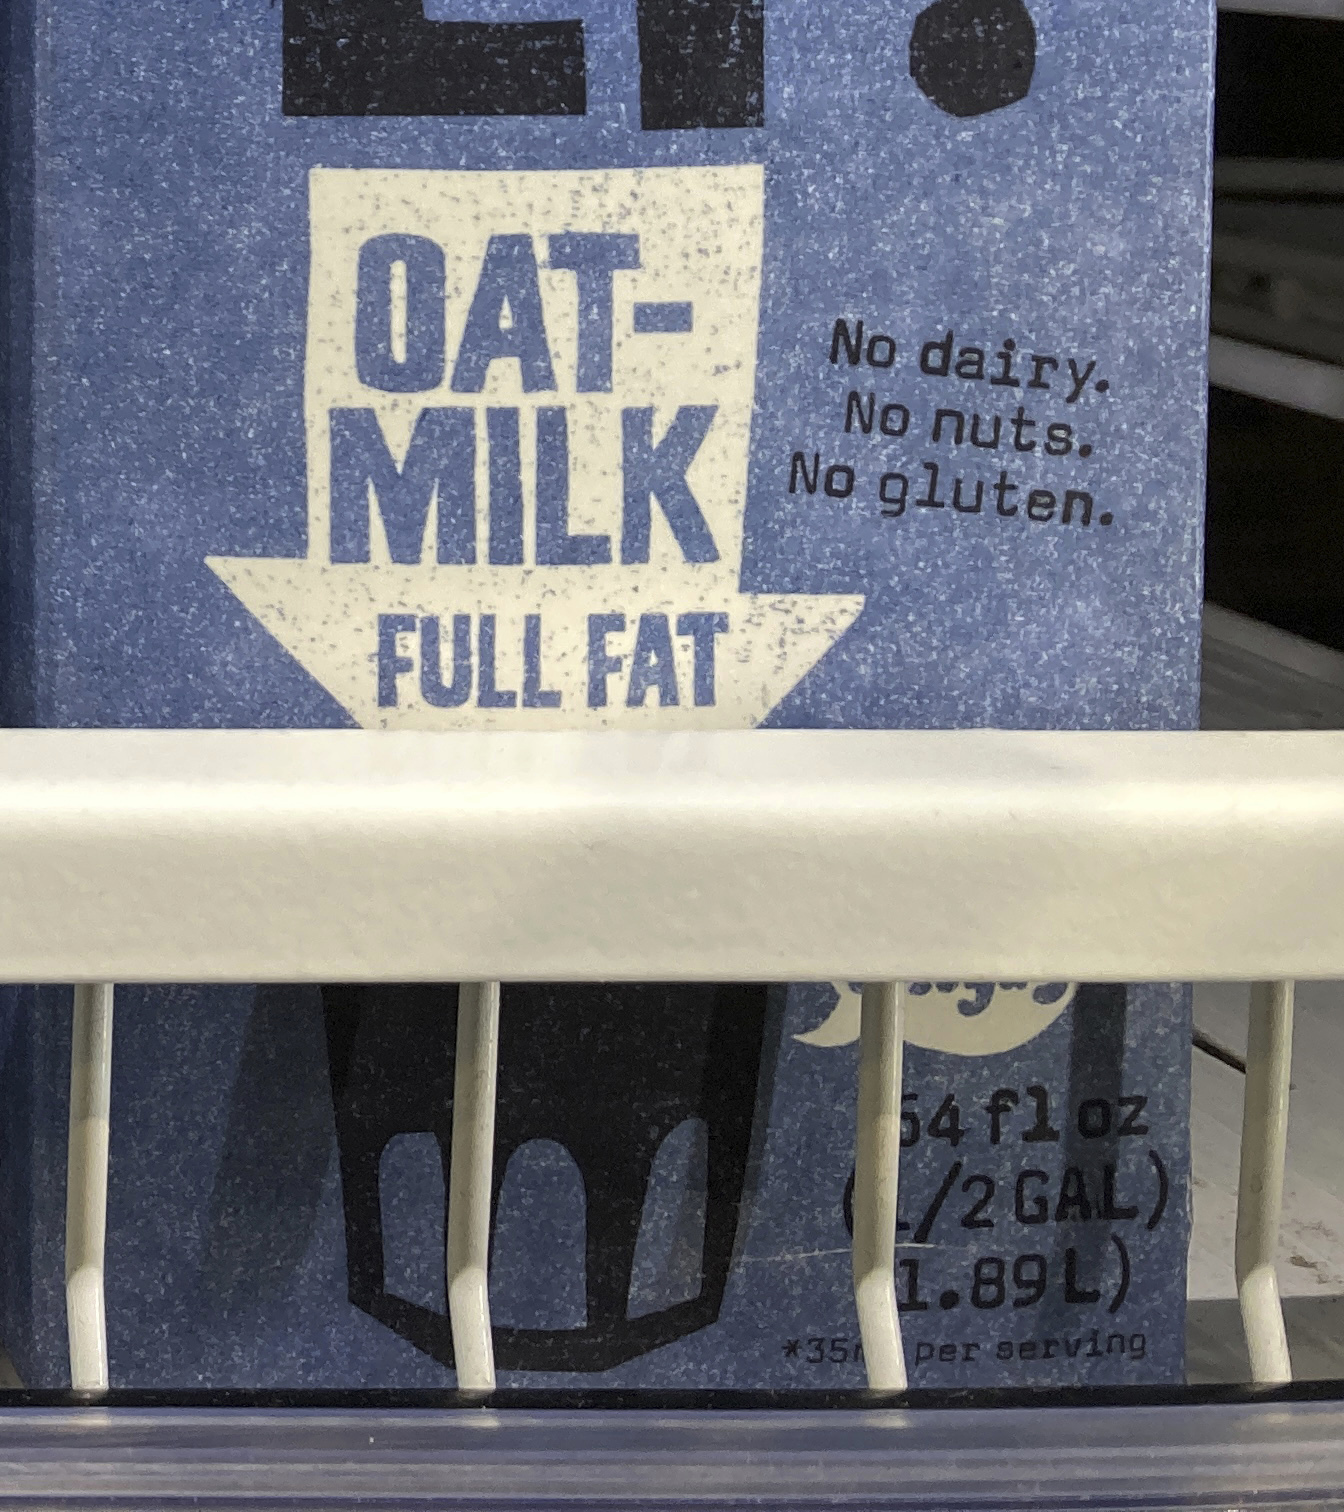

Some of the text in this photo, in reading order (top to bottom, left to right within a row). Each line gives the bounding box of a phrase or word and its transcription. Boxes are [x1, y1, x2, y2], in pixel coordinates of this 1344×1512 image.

[354, 231, 692, 395] OAT-
[830, 318, 1110, 403] No dairy.
[843, 390, 1094, 457] No nuts.
[328, 404, 721, 568] MILK
[788, 449, 1114, 528] No gluten.
[376, 612, 729, 710] FULL FAT
[984, 1085, 1060, 1146] fl
[1078, 1095, 1150, 1141] oz
[842, 1149, 1169, 1243] (/2 GAL)
[898, 1232, 1131, 1314] 1.89 L)
[914, 1328, 1147, 1367] per serving
